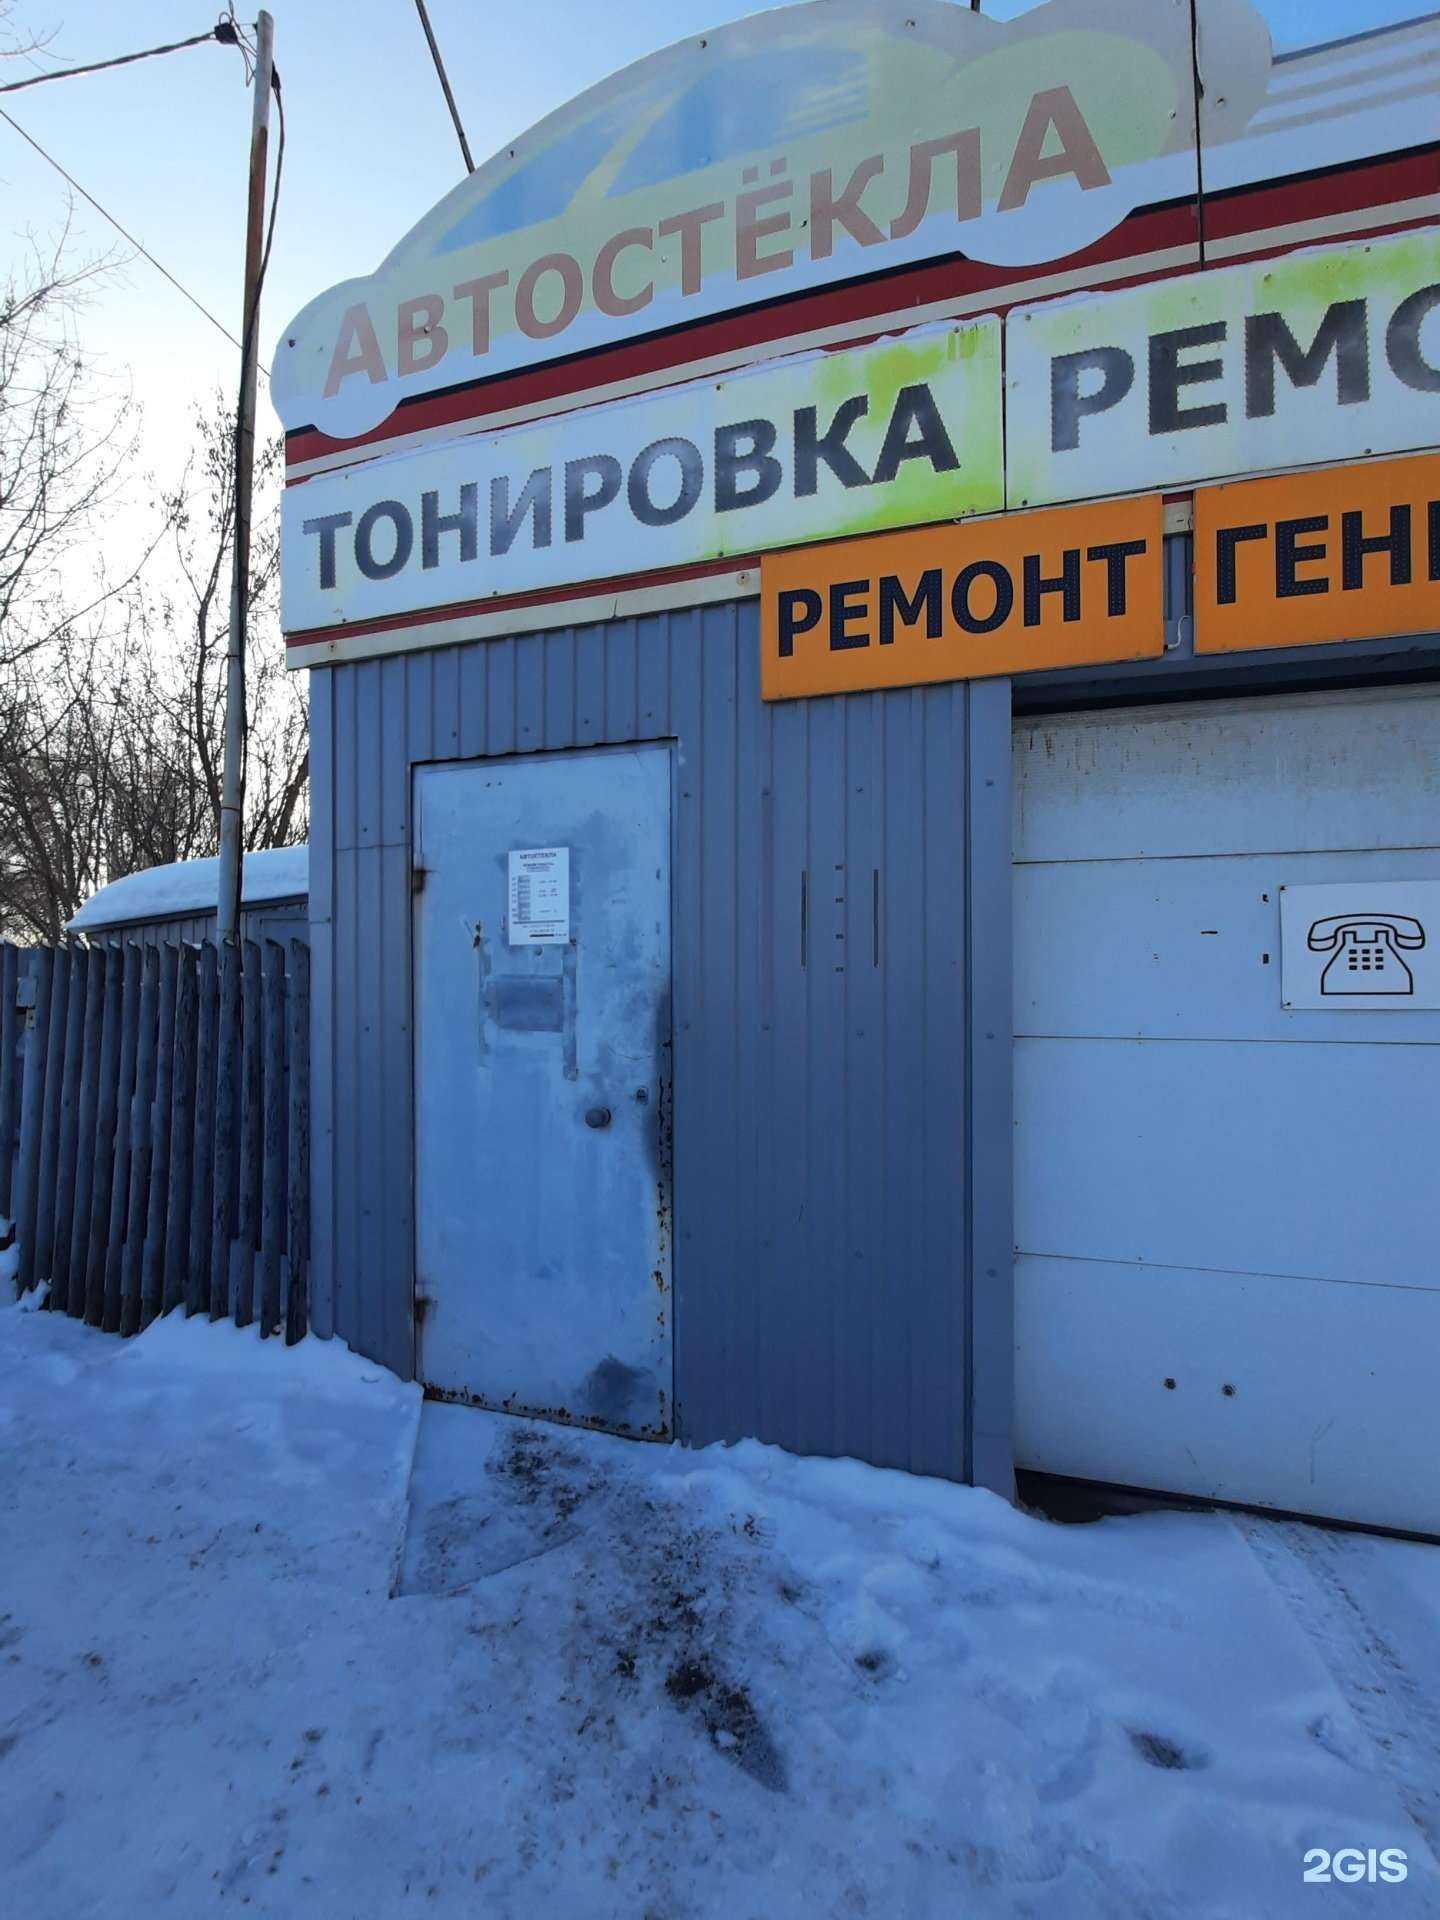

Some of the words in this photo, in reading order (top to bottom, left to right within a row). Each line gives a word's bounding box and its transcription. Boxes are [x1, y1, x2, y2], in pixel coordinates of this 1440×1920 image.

[322, 85, 1112, 399] АВТОСТЁКЛА
[301, 383, 962, 590] ТОНИРОВКА
[1216, 501, 1440, 605] ГЕН
[777, 538, 1147, 658] РЕМОНТ
